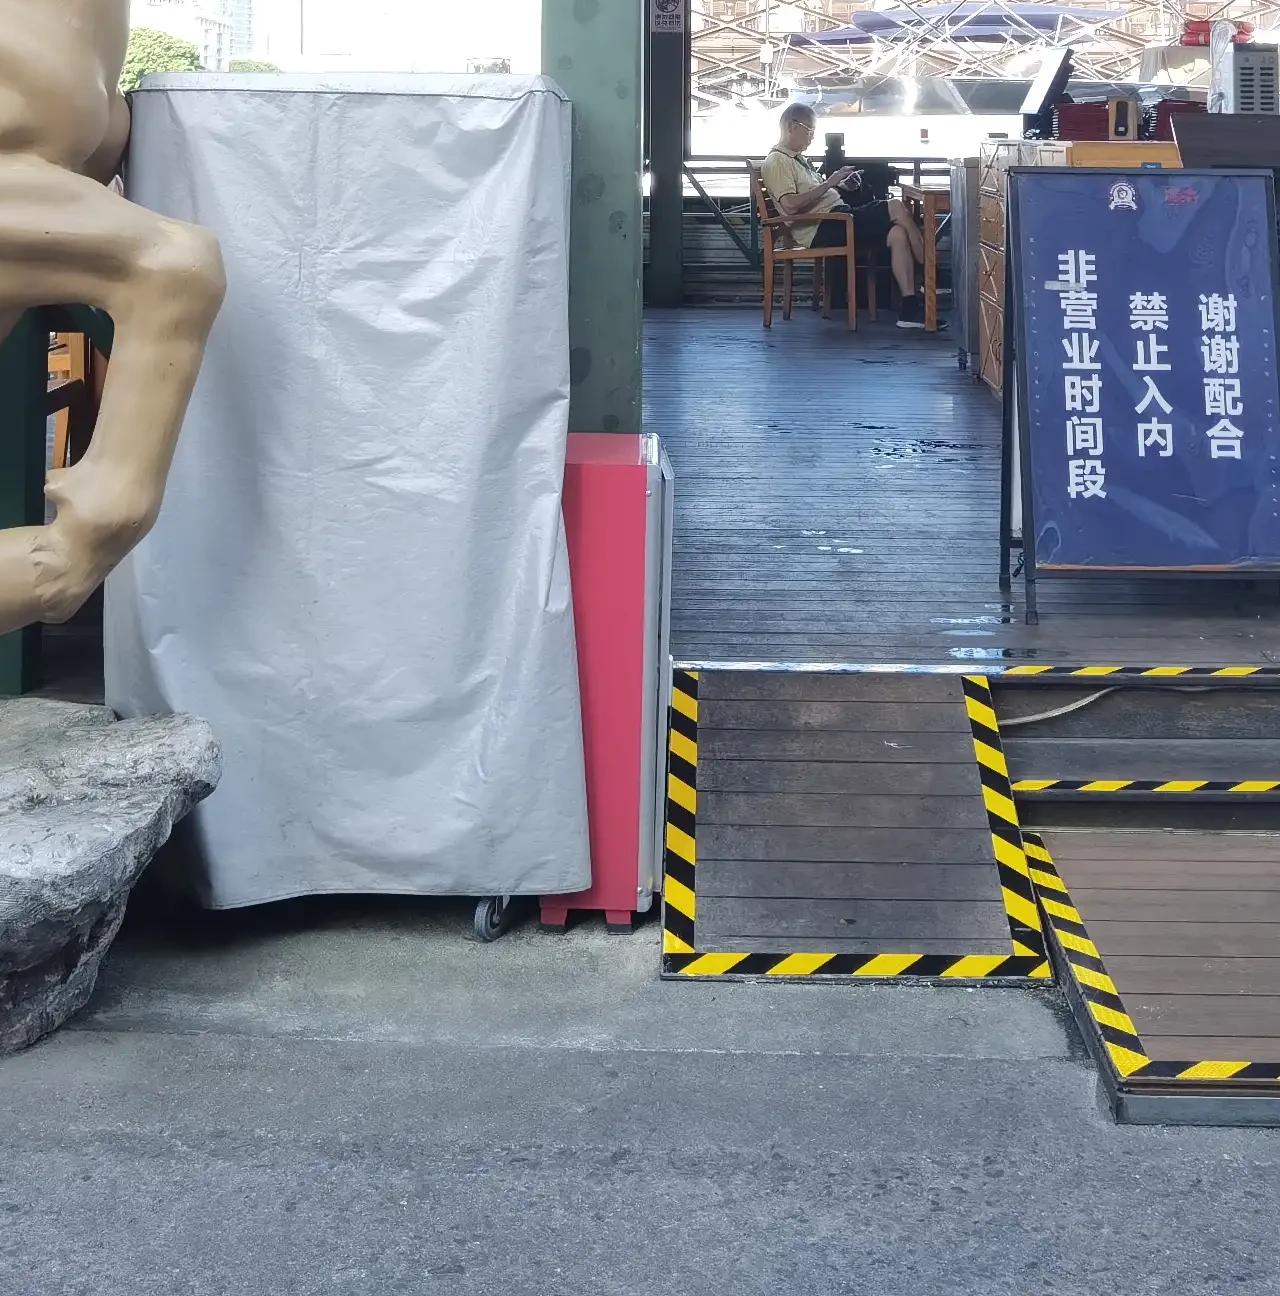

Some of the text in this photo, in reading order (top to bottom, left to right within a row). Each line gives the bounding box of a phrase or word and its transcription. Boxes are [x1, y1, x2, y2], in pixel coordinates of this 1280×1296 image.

[1057, 249, 1107, 500] 非营业时间段
[1128, 291, 1174, 458] 禁止入内
[1198, 293, 1245, 460] 谢谢配合
